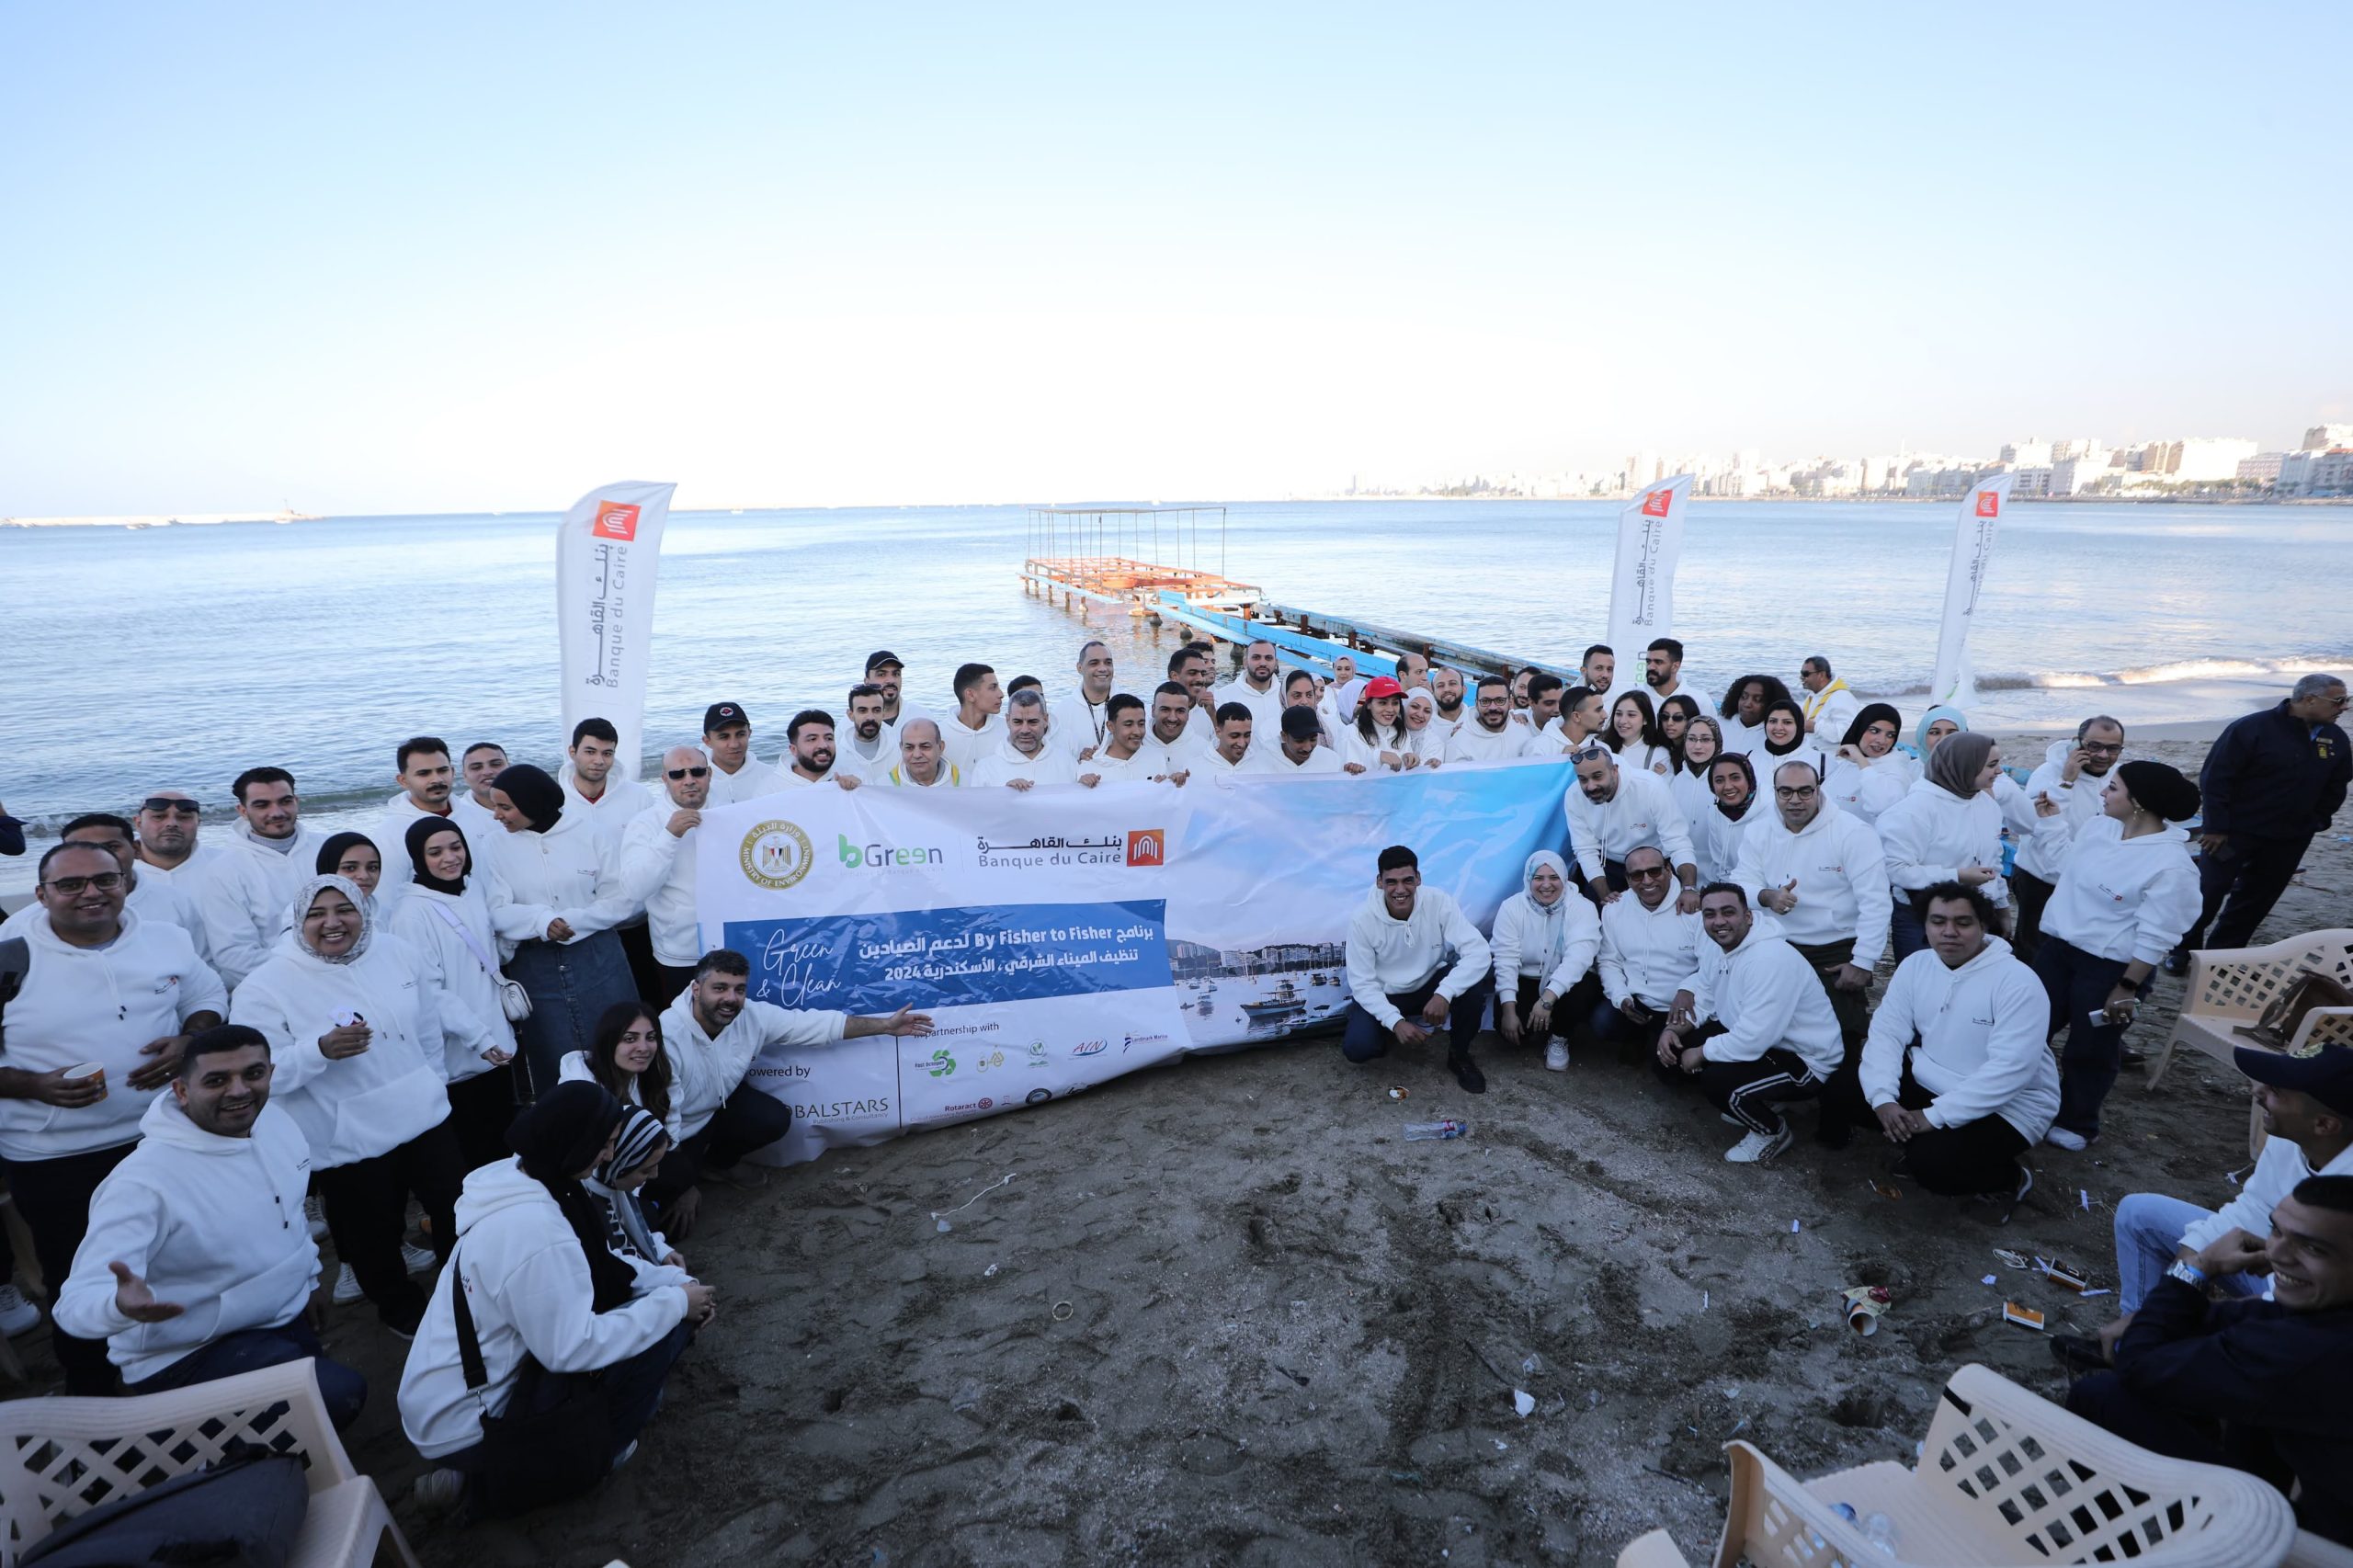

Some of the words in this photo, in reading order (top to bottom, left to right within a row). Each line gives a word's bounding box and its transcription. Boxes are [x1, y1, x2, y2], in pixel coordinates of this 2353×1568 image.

[1649, 520, 1663, 553] Caire
[612, 545, 628, 590] Caire
[1648, 559, 1656, 574] du
[1632, 562, 1647, 626] القاهرة
[1644, 579, 1655, 626] Banque
[613, 597, 624, 619] du
[585, 599, 606, 686] القاهرة
[607, 623, 624, 688] Banque
[977, 835, 1064, 855] القاهرة
[742, 846, 761, 882] MINISTRY
[760, 877, 773, 887] OF
[774, 845, 810, 887] ENVIRONMENT
[978, 855, 1043, 869] Banque
[1050, 852, 1071, 866] du
[1077, 851, 1121, 865] Caire
[974, 932, 995, 950] By
[999, 928, 1047, 945] Fisher
[1050, 927, 1066, 941] to
[1069, 926, 1112, 940] Fisher
[1116, 925, 1154, 944] برنامج
[763, 928, 834, 976] Green
[858, 936, 926, 960] الصيادين
[928, 933, 970, 957] لدعم
[1057, 950, 1097, 968] الميناء
[1098, 949, 1139, 965] تنظيف
[884, 967, 921, 981] 2024
[756, 978, 771, 999] &
[780, 962, 842, 1007] Clean
[925, 1024, 978, 1040] partnership
[979, 1021, 1000, 1032] with
[1073, 1040, 1103, 1054] AIN
[748, 1066, 792, 1077] owered
[795, 1065, 811, 1078] by
[785, 1097, 889, 1119] BALSTARS
[944, 1102, 976, 1112] Rotaract
[813, 1116, 845, 1125] Publishing
[851, 1112, 889, 1121] Consultancy
